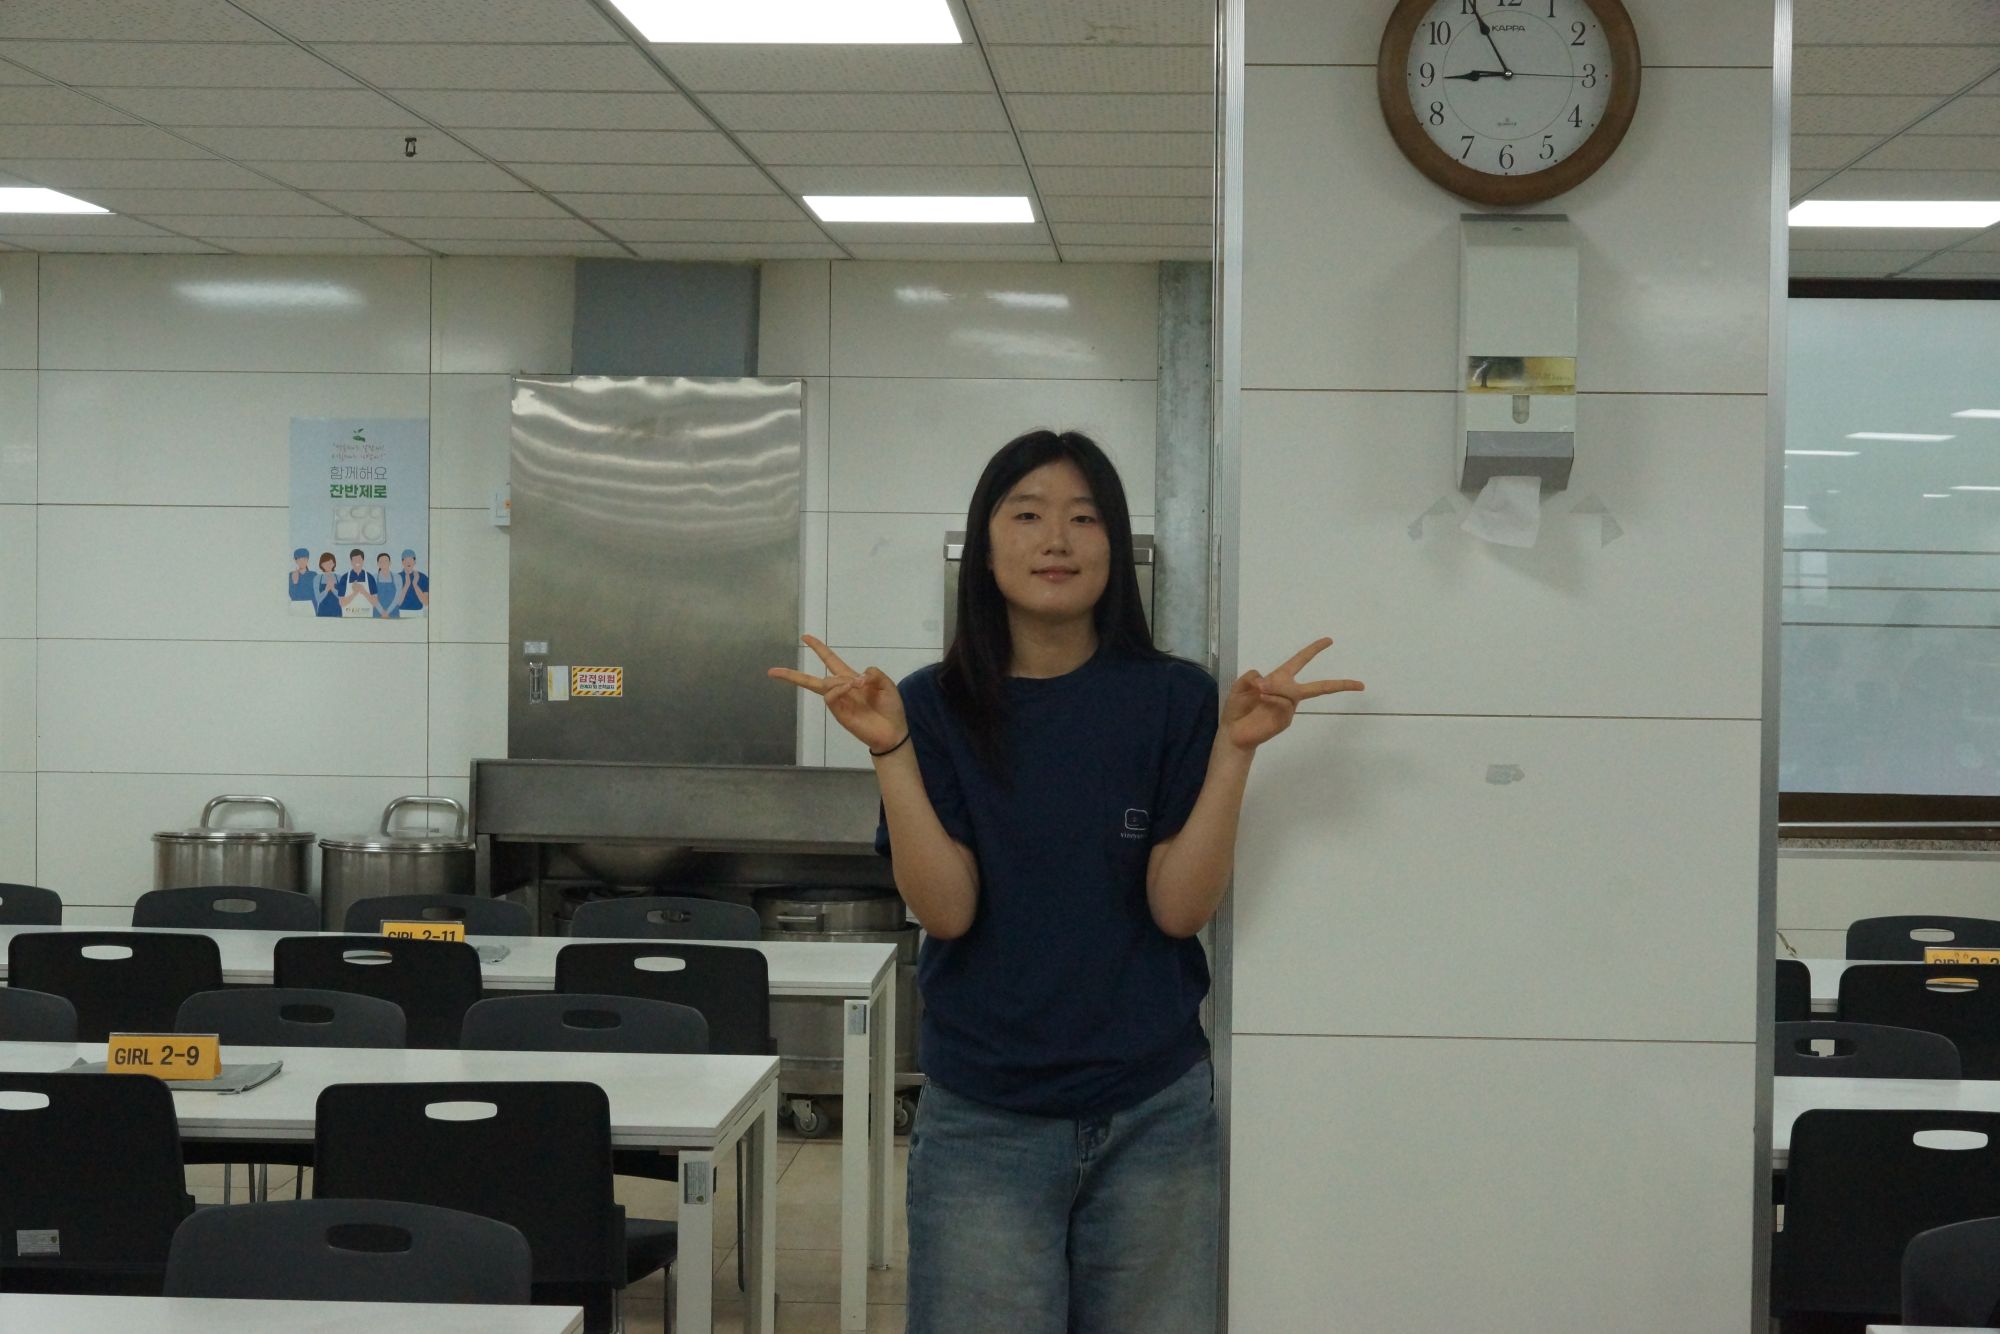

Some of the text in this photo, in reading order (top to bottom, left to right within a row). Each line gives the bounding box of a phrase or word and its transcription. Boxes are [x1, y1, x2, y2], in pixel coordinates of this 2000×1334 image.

[1429, 21, 1451, 46] 10
[1571, 21, 1586, 46] 2
[1420, 62, 1435, 88] 9
[1581, 64, 1596, 88] 3
[1429, 101, 1445, 126] 8
[1567, 104, 1583, 128] 4
[1460, 135, 1475, 160] 7
[1499, 144, 1514, 169] 6
[1539, 135, 1554, 160] 5
[329, 466, 388, 480] 함께해요
[329, 484, 388, 499] 잔반제로
[579, 674, 615, 684] 감전위험
[114, 1045, 199, 1066] GIRL 2-9
